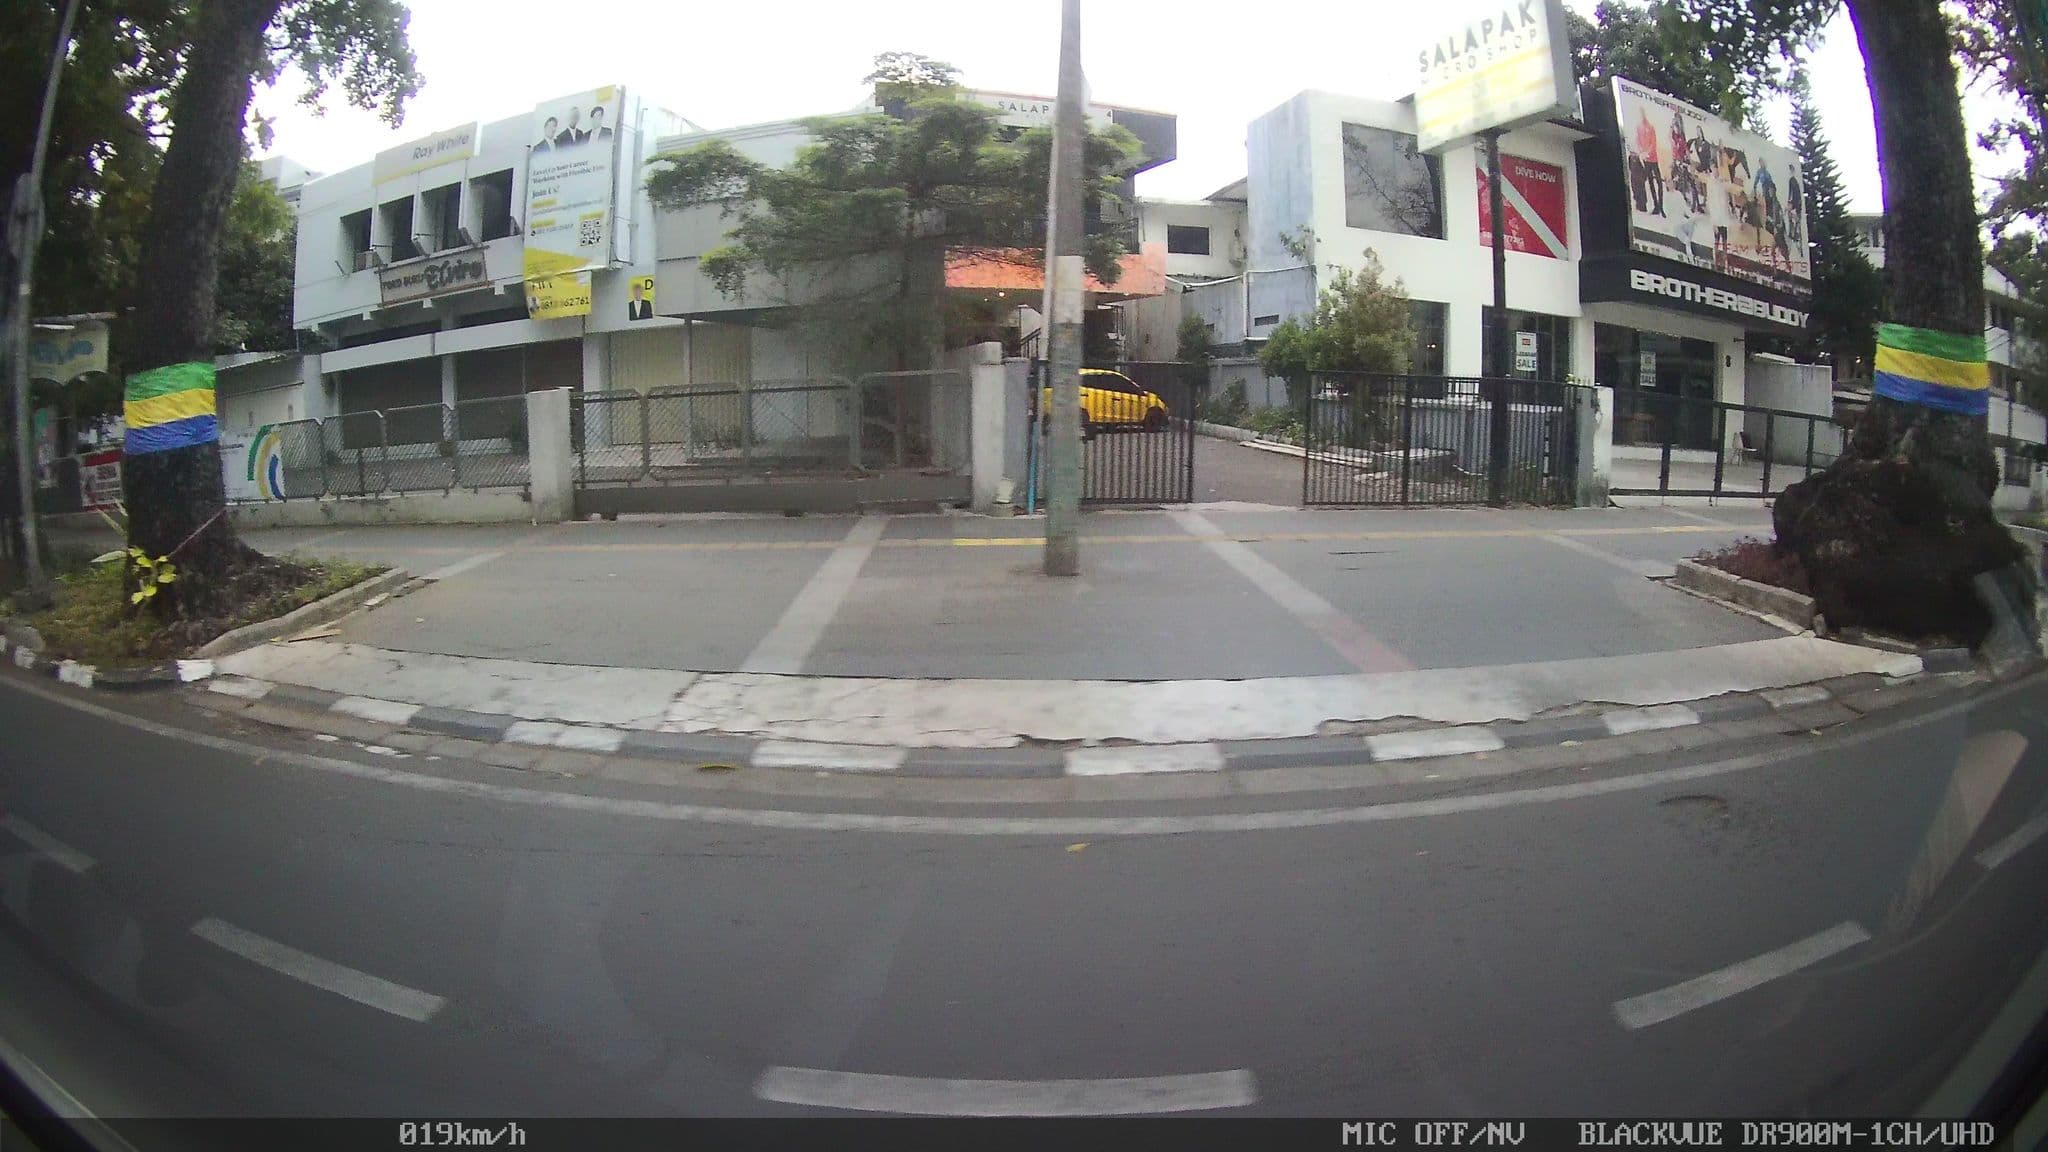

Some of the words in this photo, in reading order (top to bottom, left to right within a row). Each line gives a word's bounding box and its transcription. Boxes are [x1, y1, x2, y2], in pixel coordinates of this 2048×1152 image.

[1418, 0, 1537, 73] SALAPAK
[997, 100, 1050, 115] SALAP
[412, 146, 433, 161] Ray
[436, 133, 470, 151] White
[1514, 165, 1534, 179] DIVE
[1535, 169, 1557, 183] NOW
[1630, 269, 1810, 328] BROTHER2BUDDY
[1516, 358, 1537, 369] SALE
